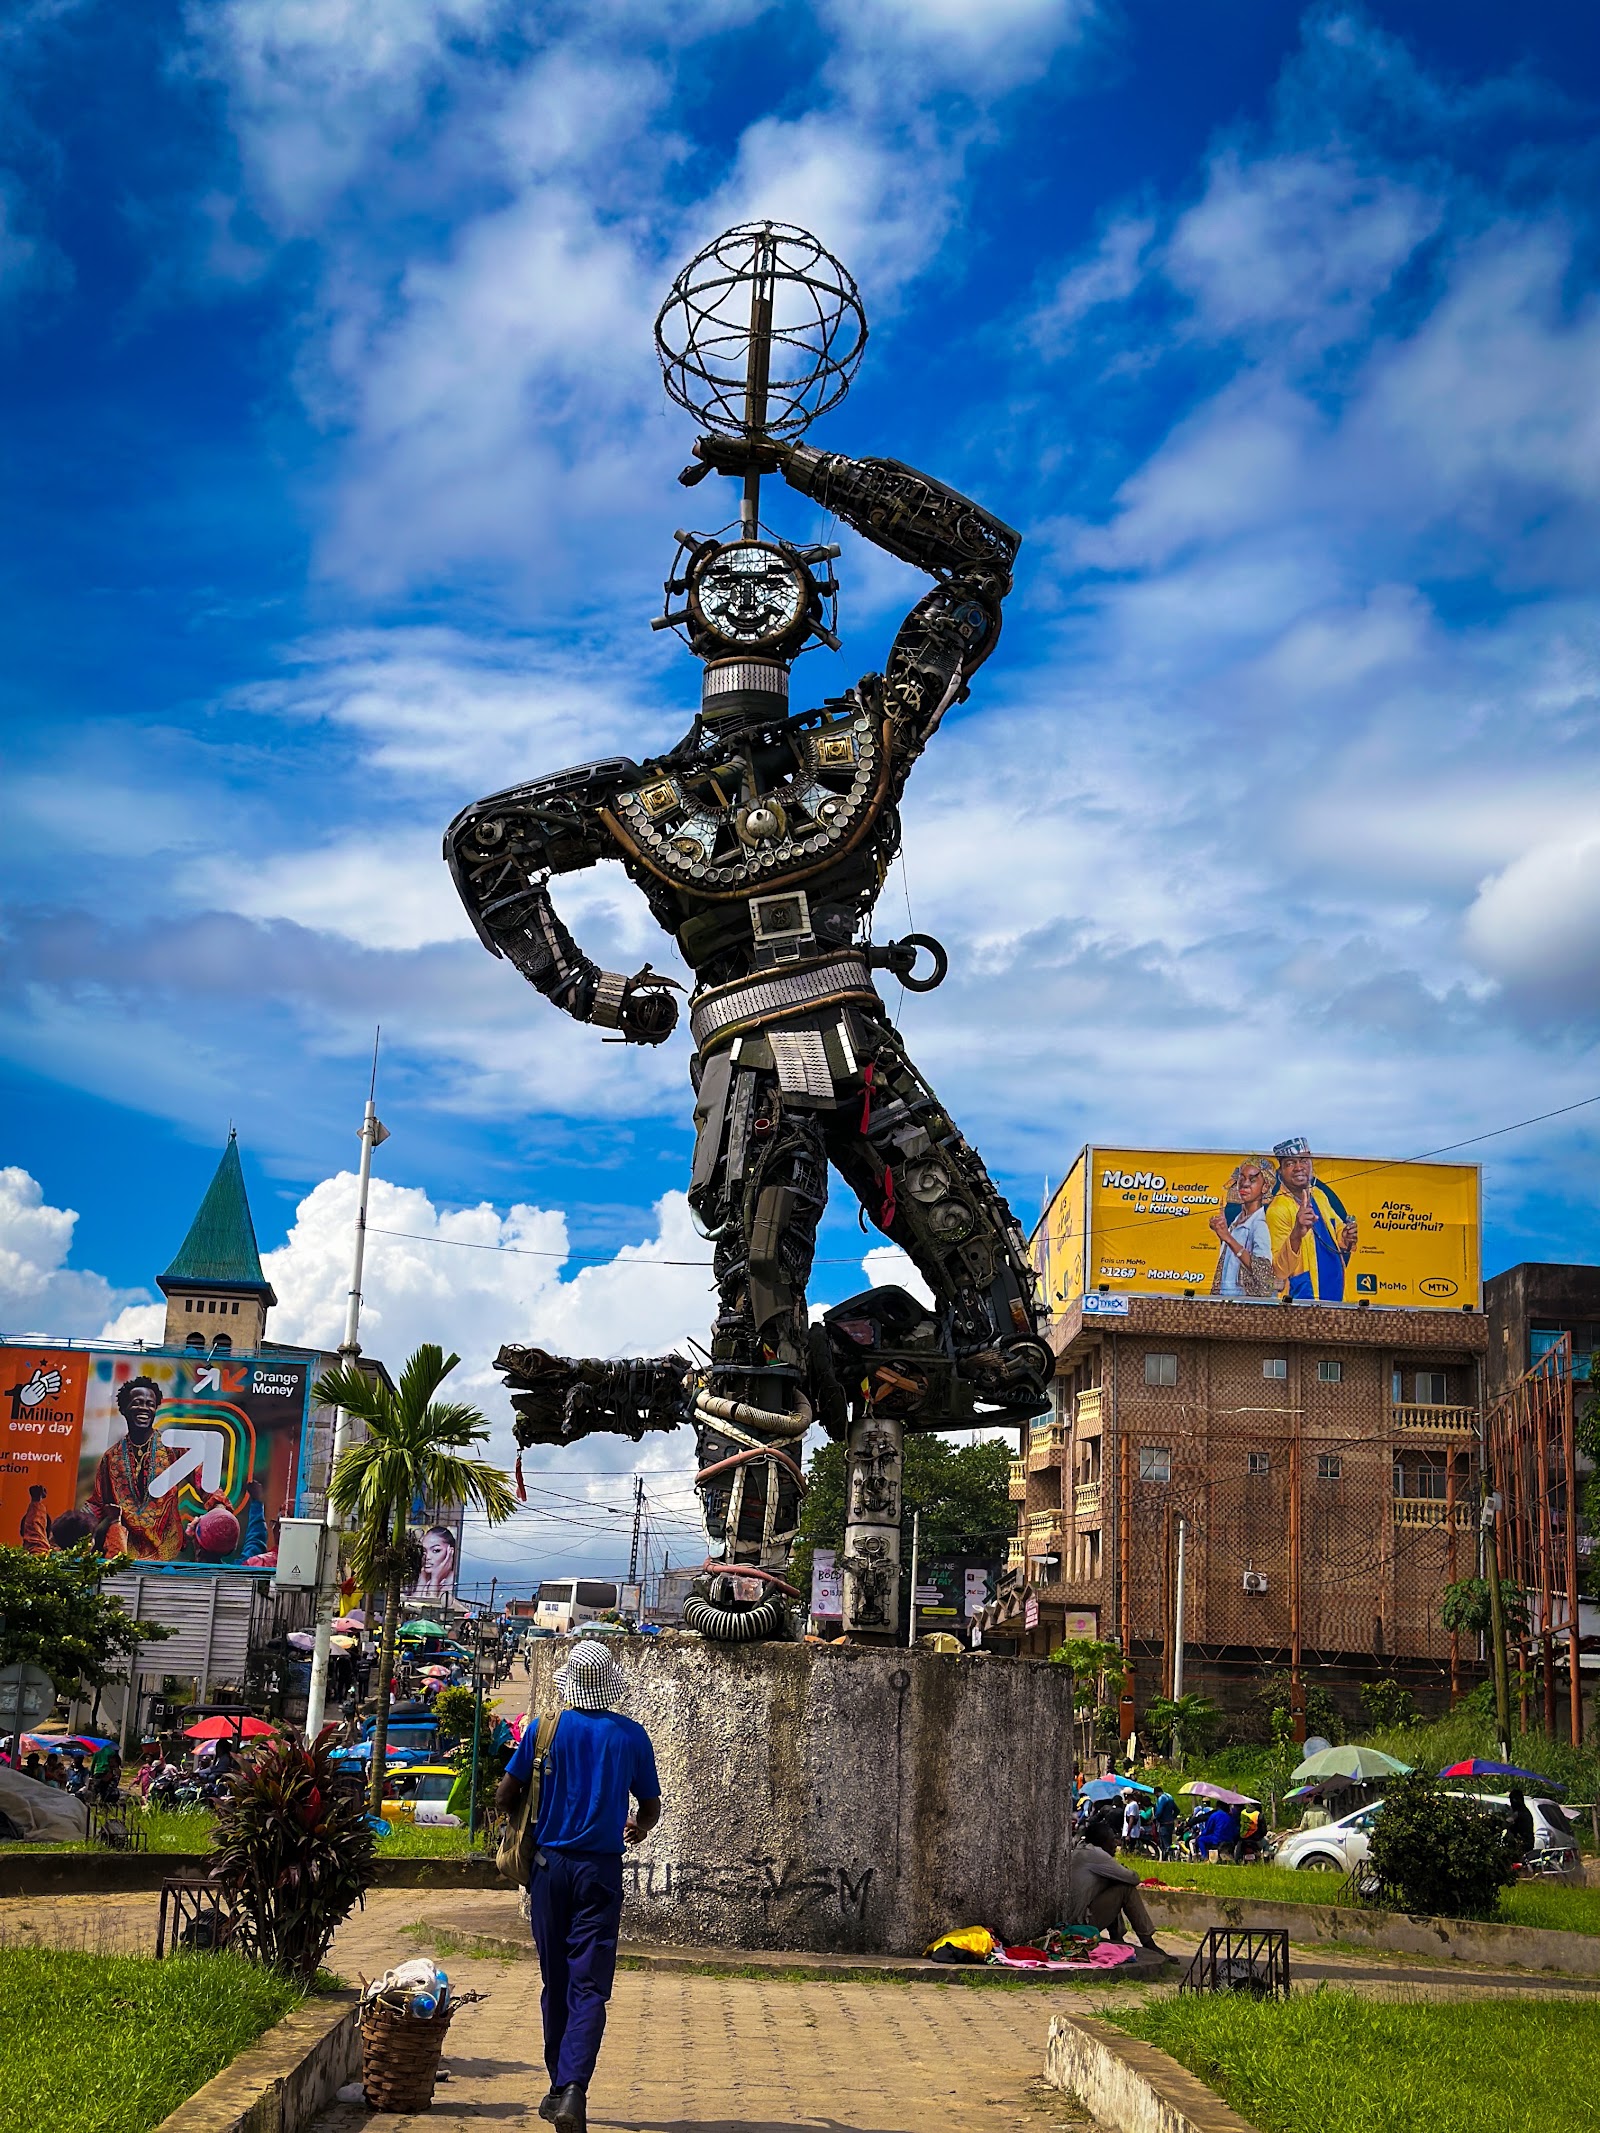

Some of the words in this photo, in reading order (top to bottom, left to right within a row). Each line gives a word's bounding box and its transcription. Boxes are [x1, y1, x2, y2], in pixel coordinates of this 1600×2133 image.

[1172, 1182, 1209, 1192] Leader
[1122, 1192, 1135, 1201] de
[1138, 1193, 1148, 1201] la
[1152, 1192, 1178, 1203] lutte
[1182, 1194, 1219, 1205] contre
[1134, 1202, 1146, 1213] le
[1149, 1204, 1190, 1217] foirage
[1381, 1201, 1413, 1212] Alors,
[1370, 1211, 1384, 1219] on
[1387, 1211, 1406, 1220] fait
[1408, 1212, 1432, 1222] quoi
[1373, 1220, 1444, 1231] Aujourd'hui?
[1126, 1258, 1146, 1266] MoMo
[1147, 1269, 1180, 1280] MoMo
[1181, 1270, 1205, 1282] App
[1379, 1281, 1407, 1291] MoMo
[1428, 1283, 1449, 1292] MTN
[253, 1370, 299, 1385] Orange
[252, 1382, 294, 1397] Money
[20, 1407, 74, 1422] Million
[9, 1422, 45, 1435] every
[48, 1422, 73, 1436] day
[0, 1463, 29, 1474] ction
[930, 1570, 950, 1578] PLAY
[937, 1578, 953, 1586] PAY
